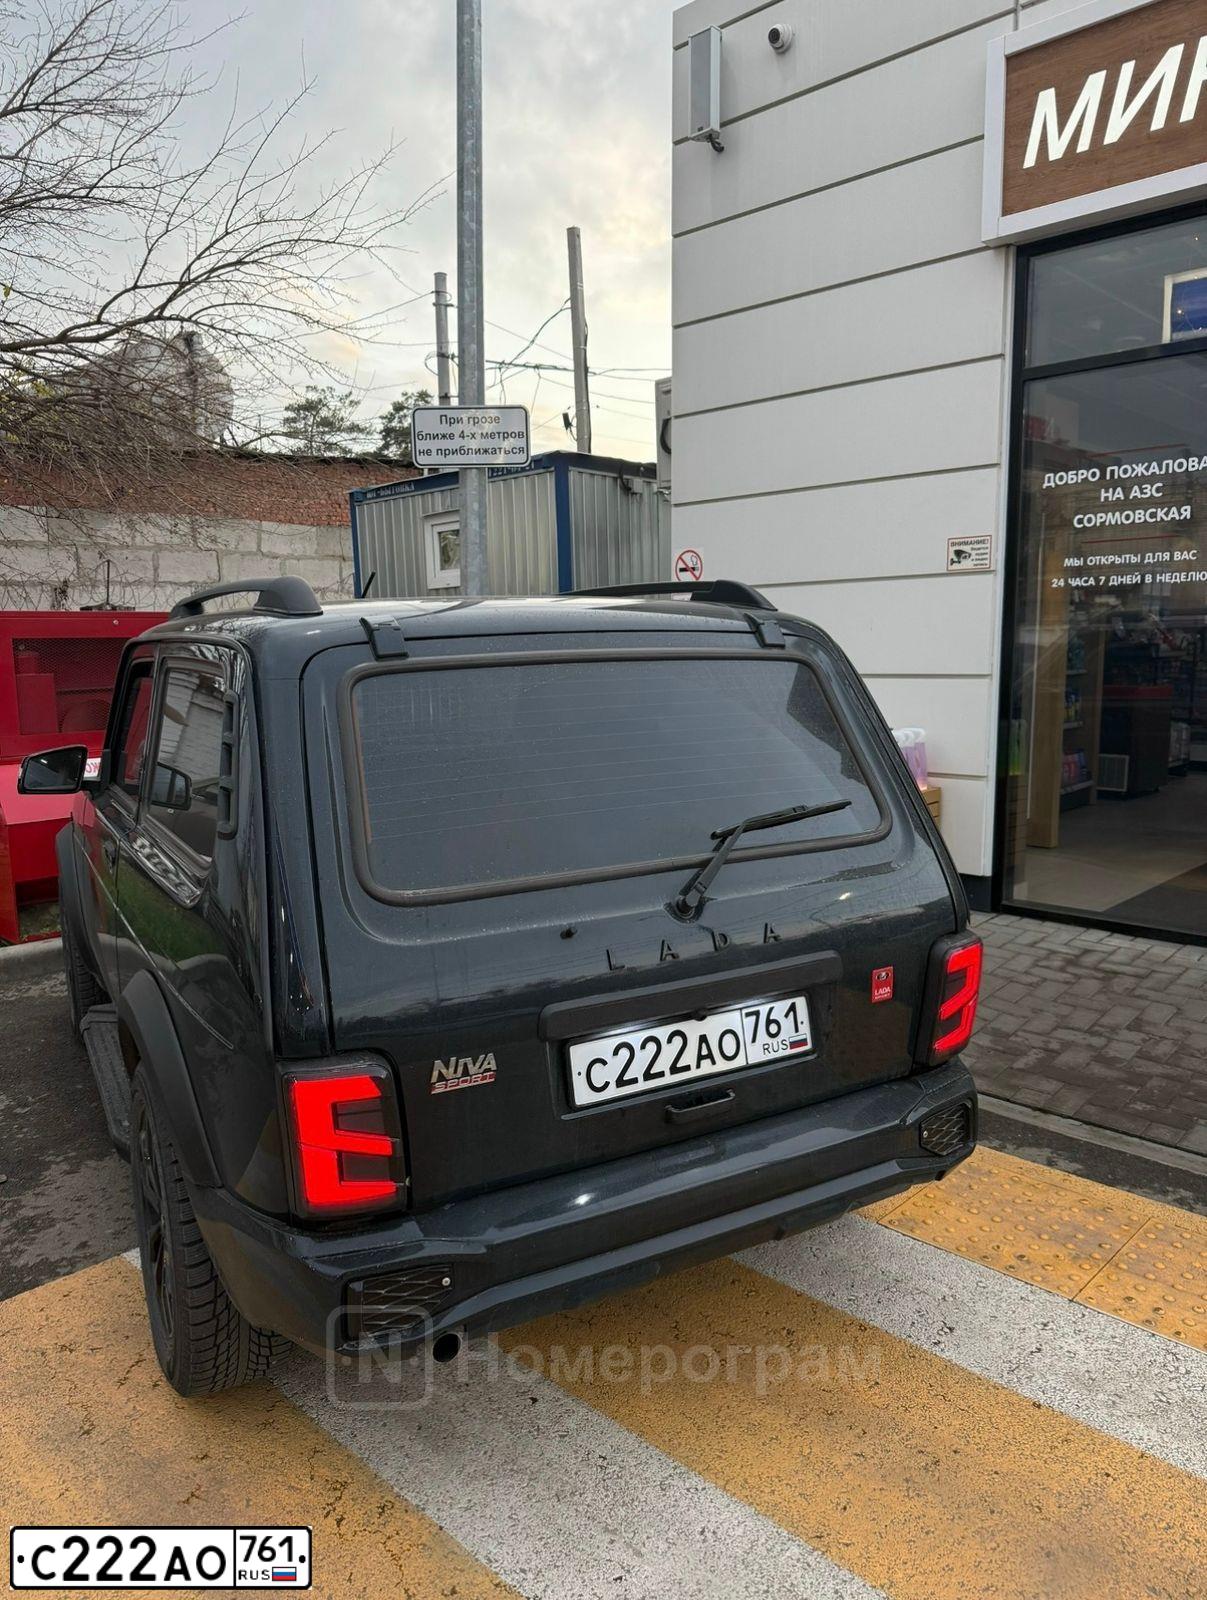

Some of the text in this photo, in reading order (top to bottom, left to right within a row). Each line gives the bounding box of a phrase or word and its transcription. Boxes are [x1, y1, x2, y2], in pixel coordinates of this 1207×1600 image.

[439, 414, 501, 427] При грозе
[416, 430, 525, 442] ближе 4-х метров
[418, 445, 525, 459] не приближаться
[1042, 468, 1100, 489] ДОБРО
[1100, 483, 1163, 502] НА АЗС
[1073, 505, 1191, 528] СОРМОВСКАЯ
[1064, 550, 1198, 567] МЫ ОТКРЫТЫ ДЛЯ ВАС
[1052, 570, 1207, 588] 24 ЧАСА 7 ДНЕЙ В НЕДЕЛЮ
[606, 922, 782, 971] LADA
[585, 1001, 800, 1094] С222АО 761
[762, 1039, 789, 1056] RUS
[430, 1052, 498, 1084] NIVA
[434, 1072, 496, 1090] SPORT
